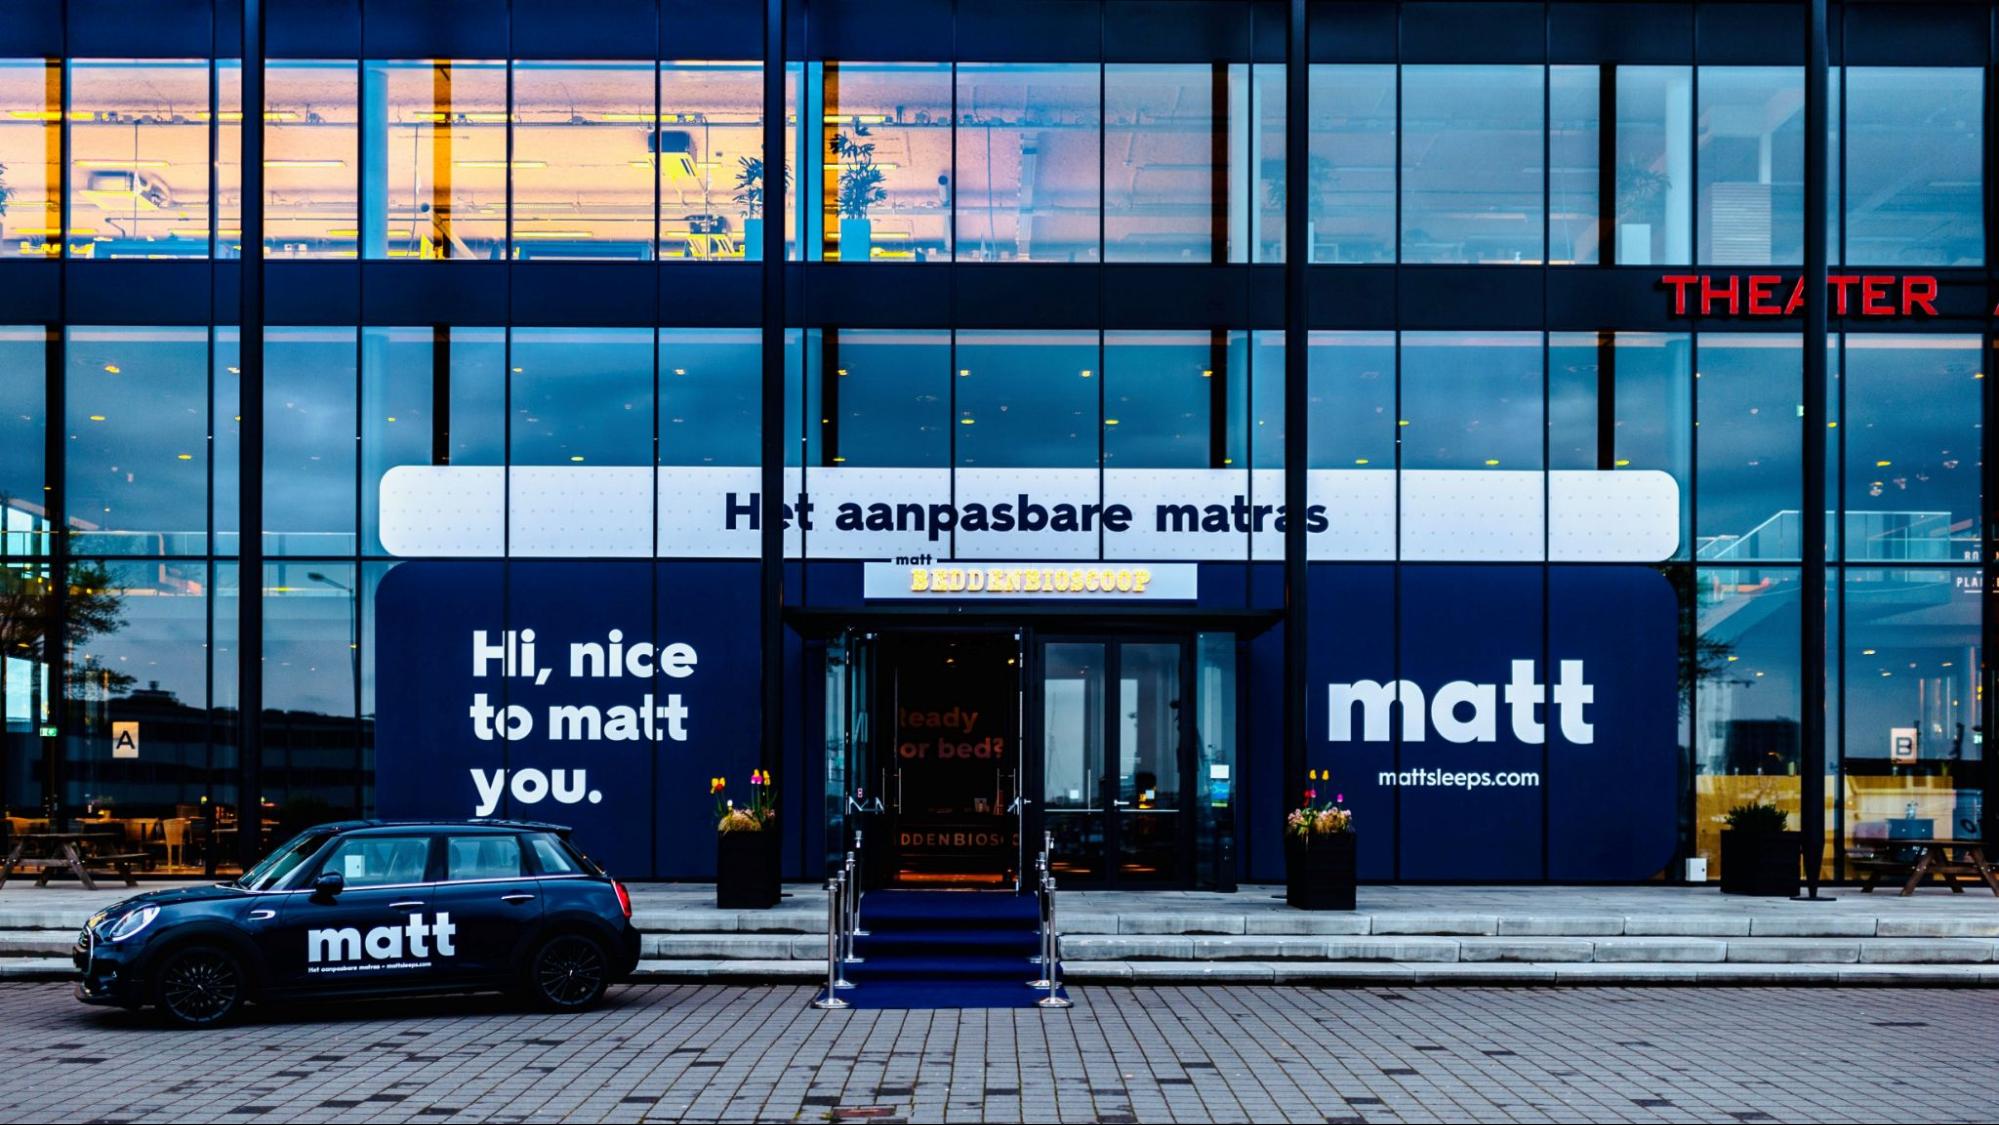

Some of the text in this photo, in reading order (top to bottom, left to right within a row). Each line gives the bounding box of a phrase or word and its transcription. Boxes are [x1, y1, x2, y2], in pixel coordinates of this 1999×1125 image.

[835, 493, 1133, 541] aanpasbare
[896, 553, 932, 565] matt
[911, 569, 1151, 592] BEDDENBIOSCOOP
[473, 628, 698, 685] Hi, nice
[1328, 659, 1594, 744] matt
[469, 693, 688, 741] to matt
[900, 706, 978, 734] eady
[116, 730, 136, 750] A
[938, 737, 1004, 759] bed?
[1895, 737, 1912, 756] B
[1378, 768, 1540, 790] mattsleeps.com
[469, 767, 602, 817] you.
[308, 912, 456, 962] matt
[386, 962, 432, 970] mattsleeps.com
